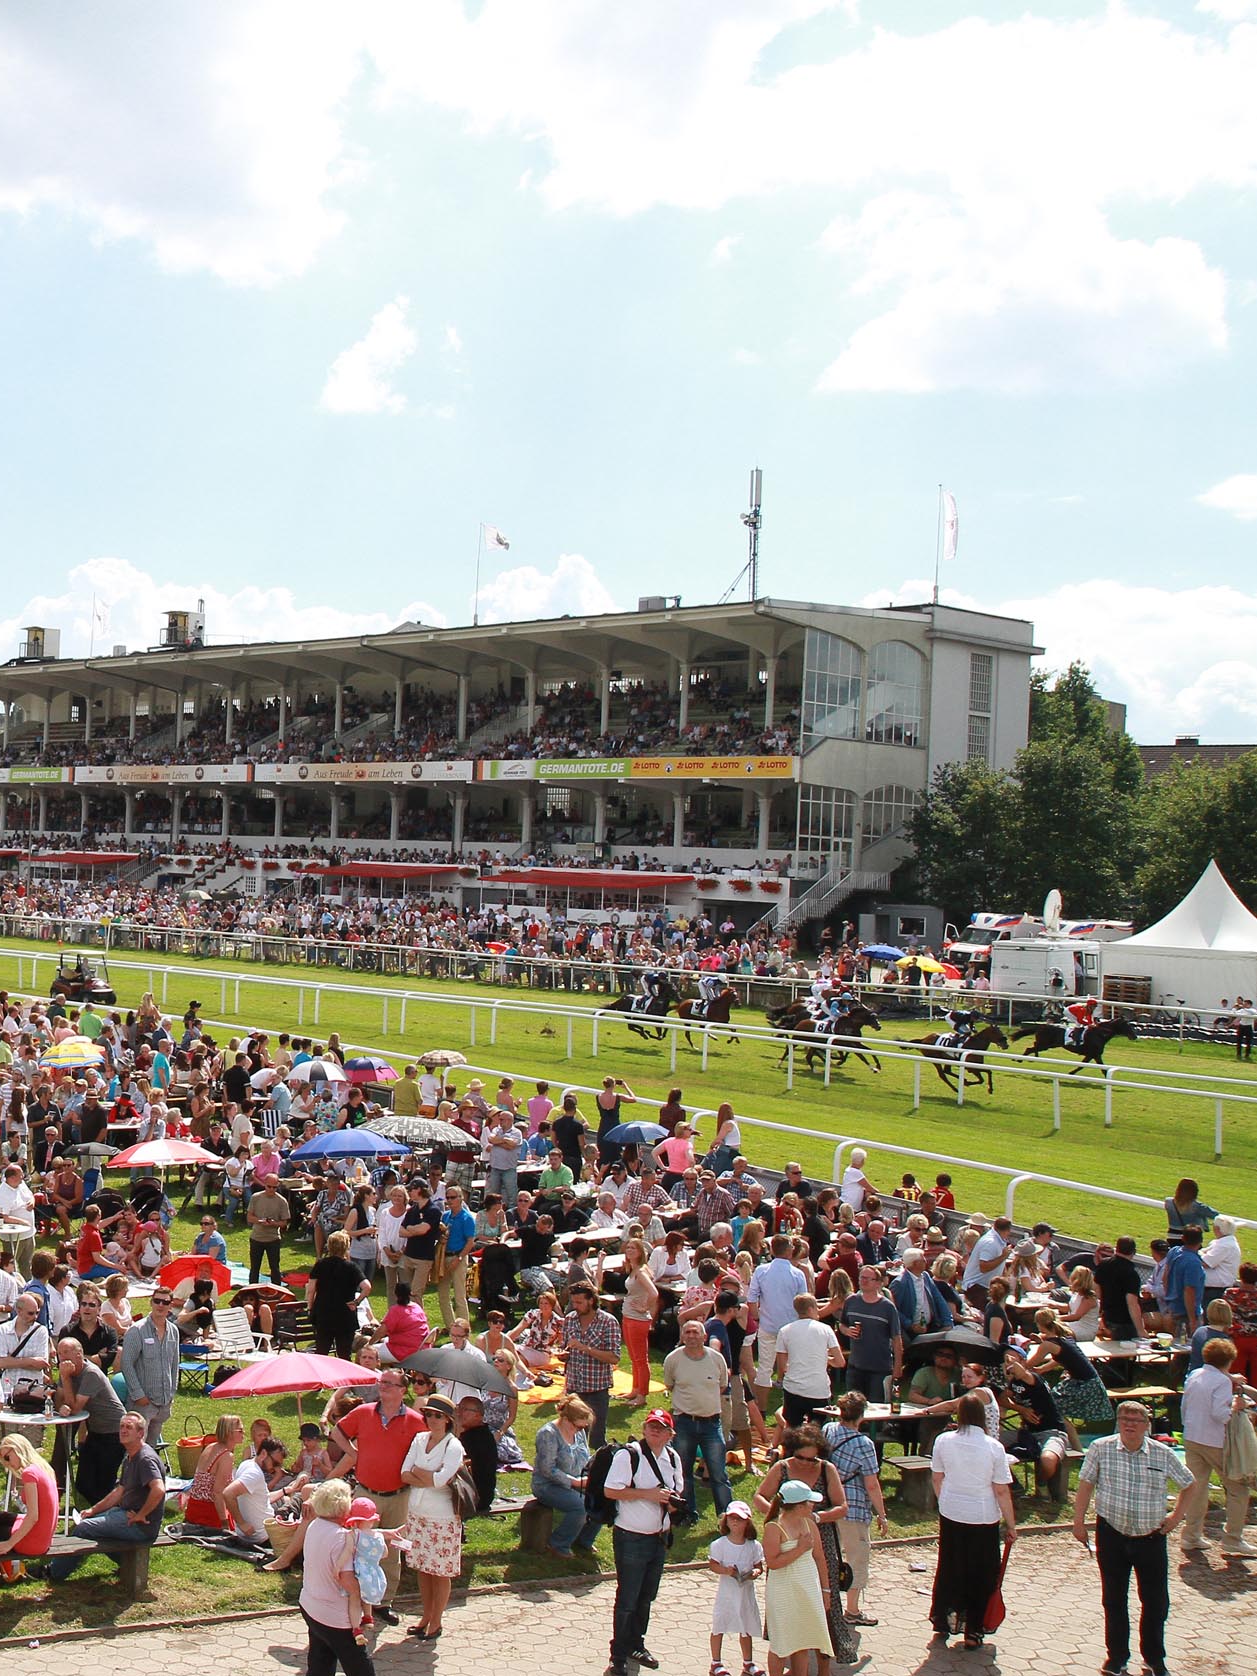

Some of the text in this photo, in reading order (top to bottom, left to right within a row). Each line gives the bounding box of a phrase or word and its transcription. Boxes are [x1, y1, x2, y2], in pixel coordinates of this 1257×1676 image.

[539, 763, 625, 774] GERMANTOTE.DE
[766, 761, 788, 769] LOTTO
[172, 770, 189, 780] Leben
[314, 770, 327, 779] Aus
[329, 769, 353, 778] Freude
[381, 769, 404, 778] Leben
[817, 1021, 824, 1032] 8
[939, 1037, 951, 1047] 10
